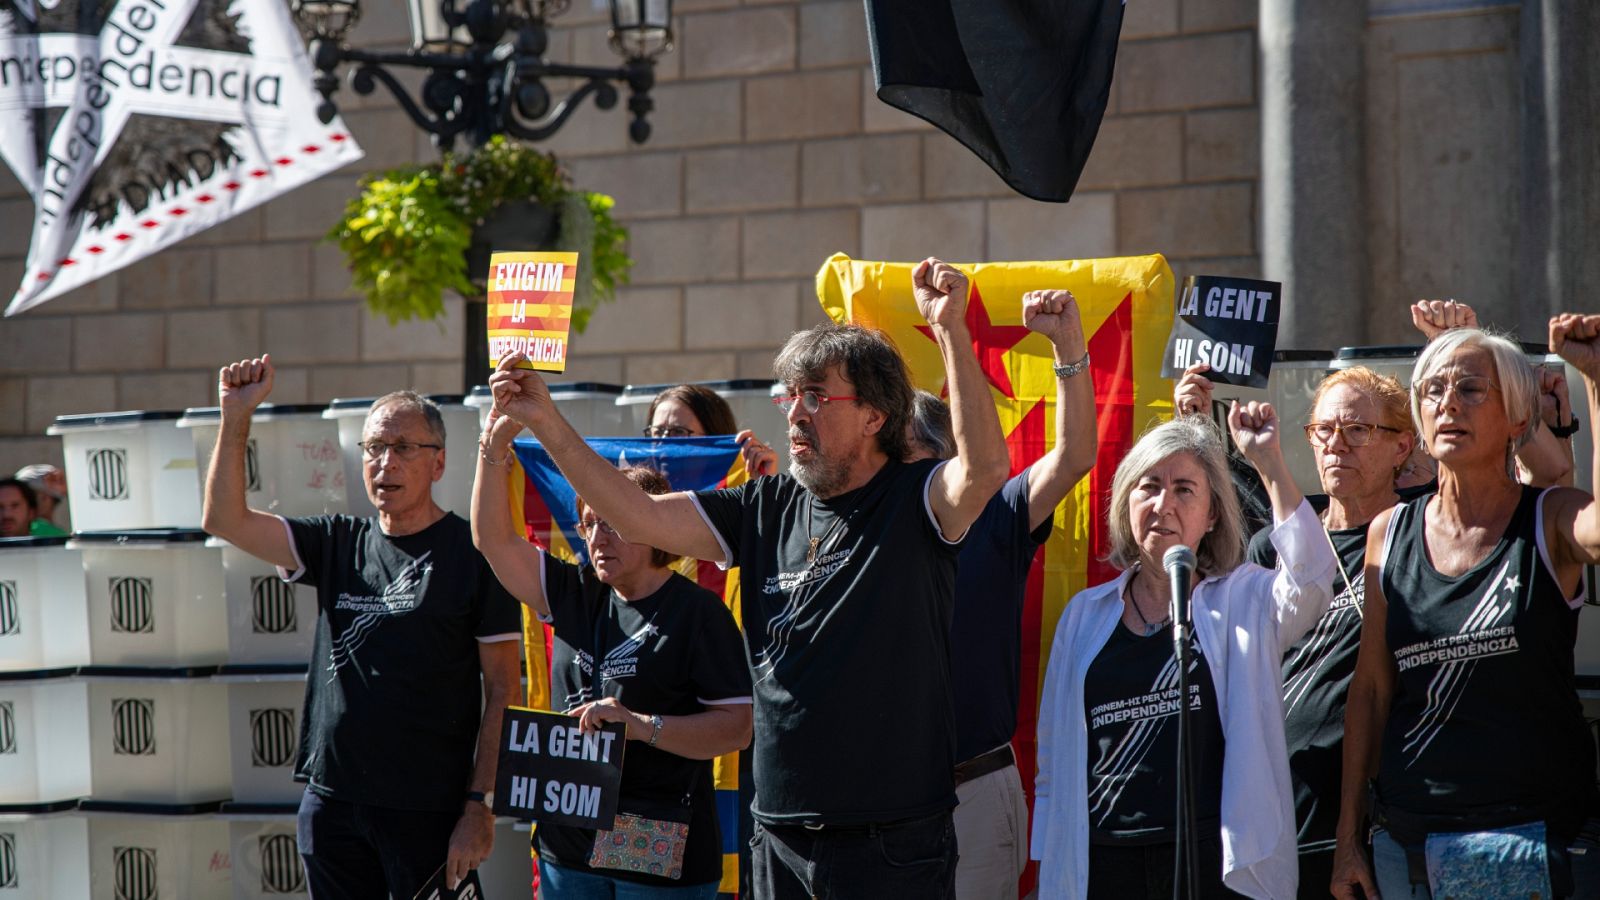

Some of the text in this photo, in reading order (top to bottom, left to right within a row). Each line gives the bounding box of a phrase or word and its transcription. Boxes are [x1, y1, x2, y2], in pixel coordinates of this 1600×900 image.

[495, 261, 564, 292] EXIGIM
[511, 299, 526, 323] LA
[1178, 286, 1272, 323] LA GENT
[1173, 338, 1254, 376] HI SOM
[1394, 638, 1447, 660] TORNEM-HI
[1449, 633, 1470, 646] PER
[1398, 637, 1519, 673] INDEPENDÈNCIA
[1090, 684, 1200, 717] TORNEM-HI PER VÈNER
[508, 720, 617, 763] LA GENT
[510, 775, 602, 819] HI SOM
